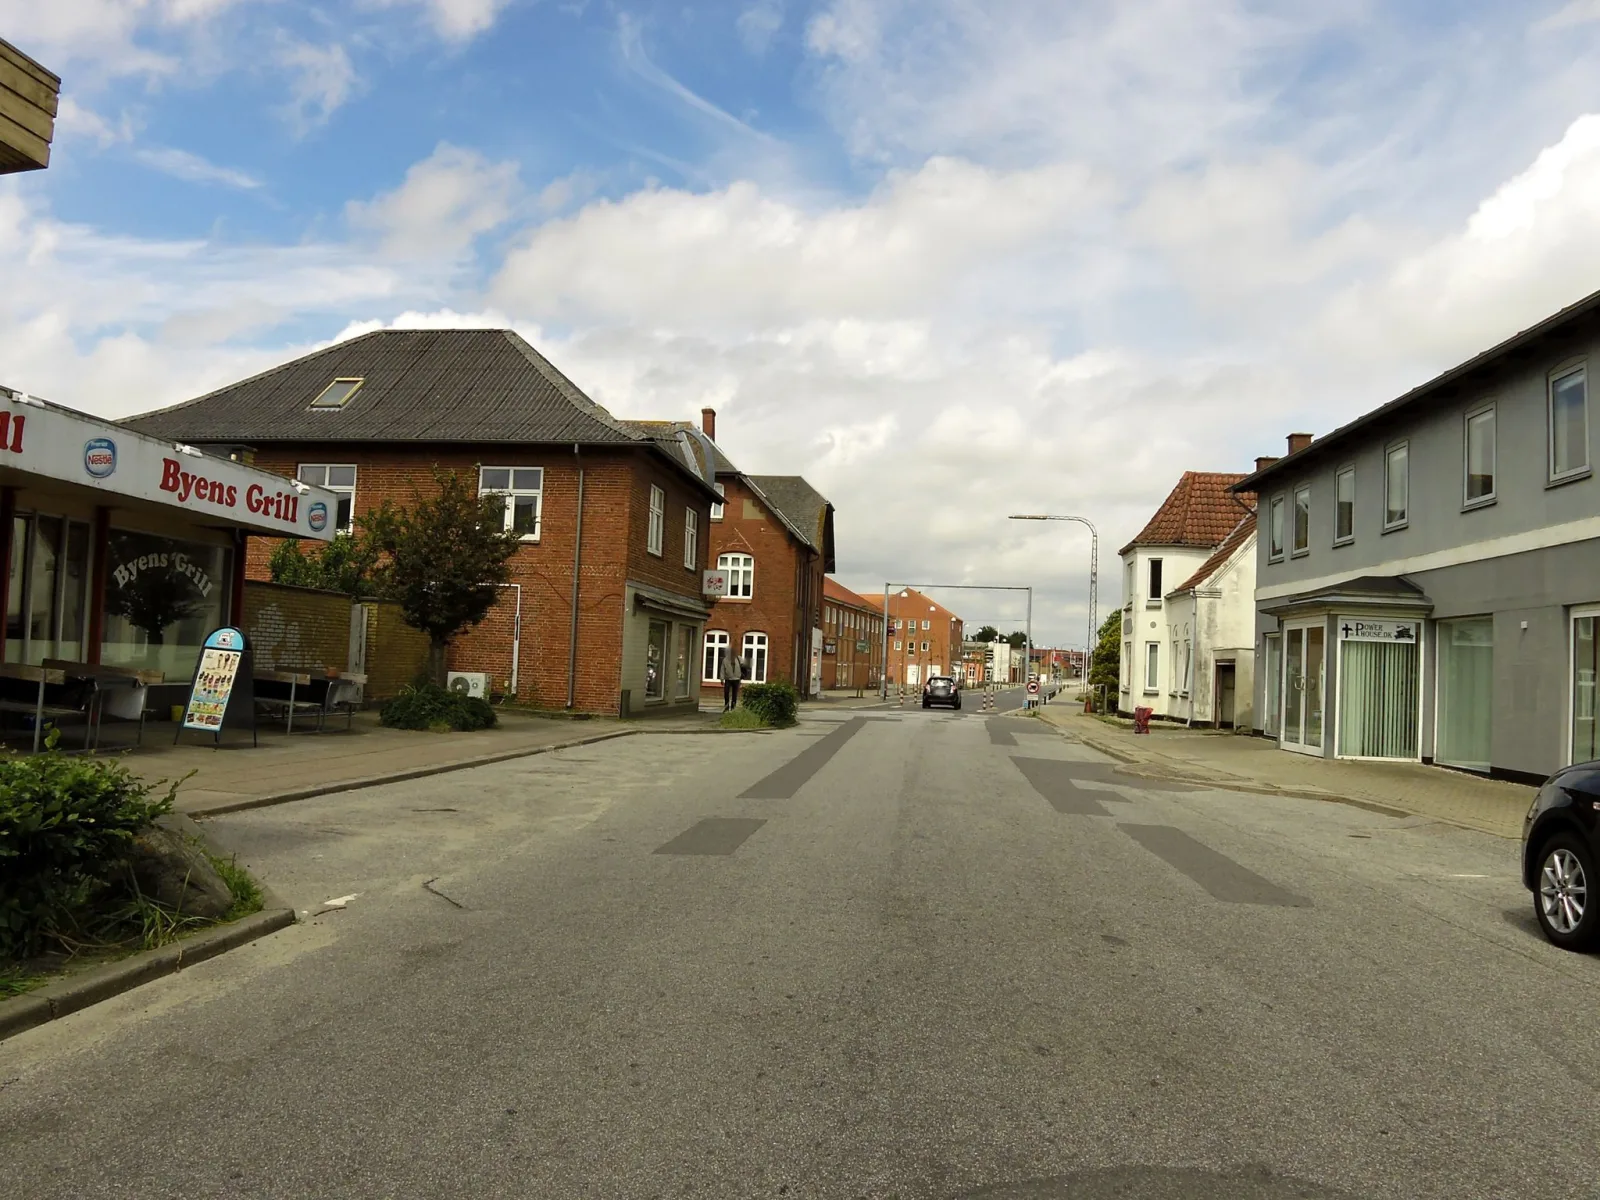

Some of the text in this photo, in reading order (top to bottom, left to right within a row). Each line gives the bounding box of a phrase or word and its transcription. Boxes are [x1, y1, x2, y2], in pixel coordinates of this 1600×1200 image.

[160, 458, 298, 523] Byens Grill
[114, 553, 168, 588] Byens
